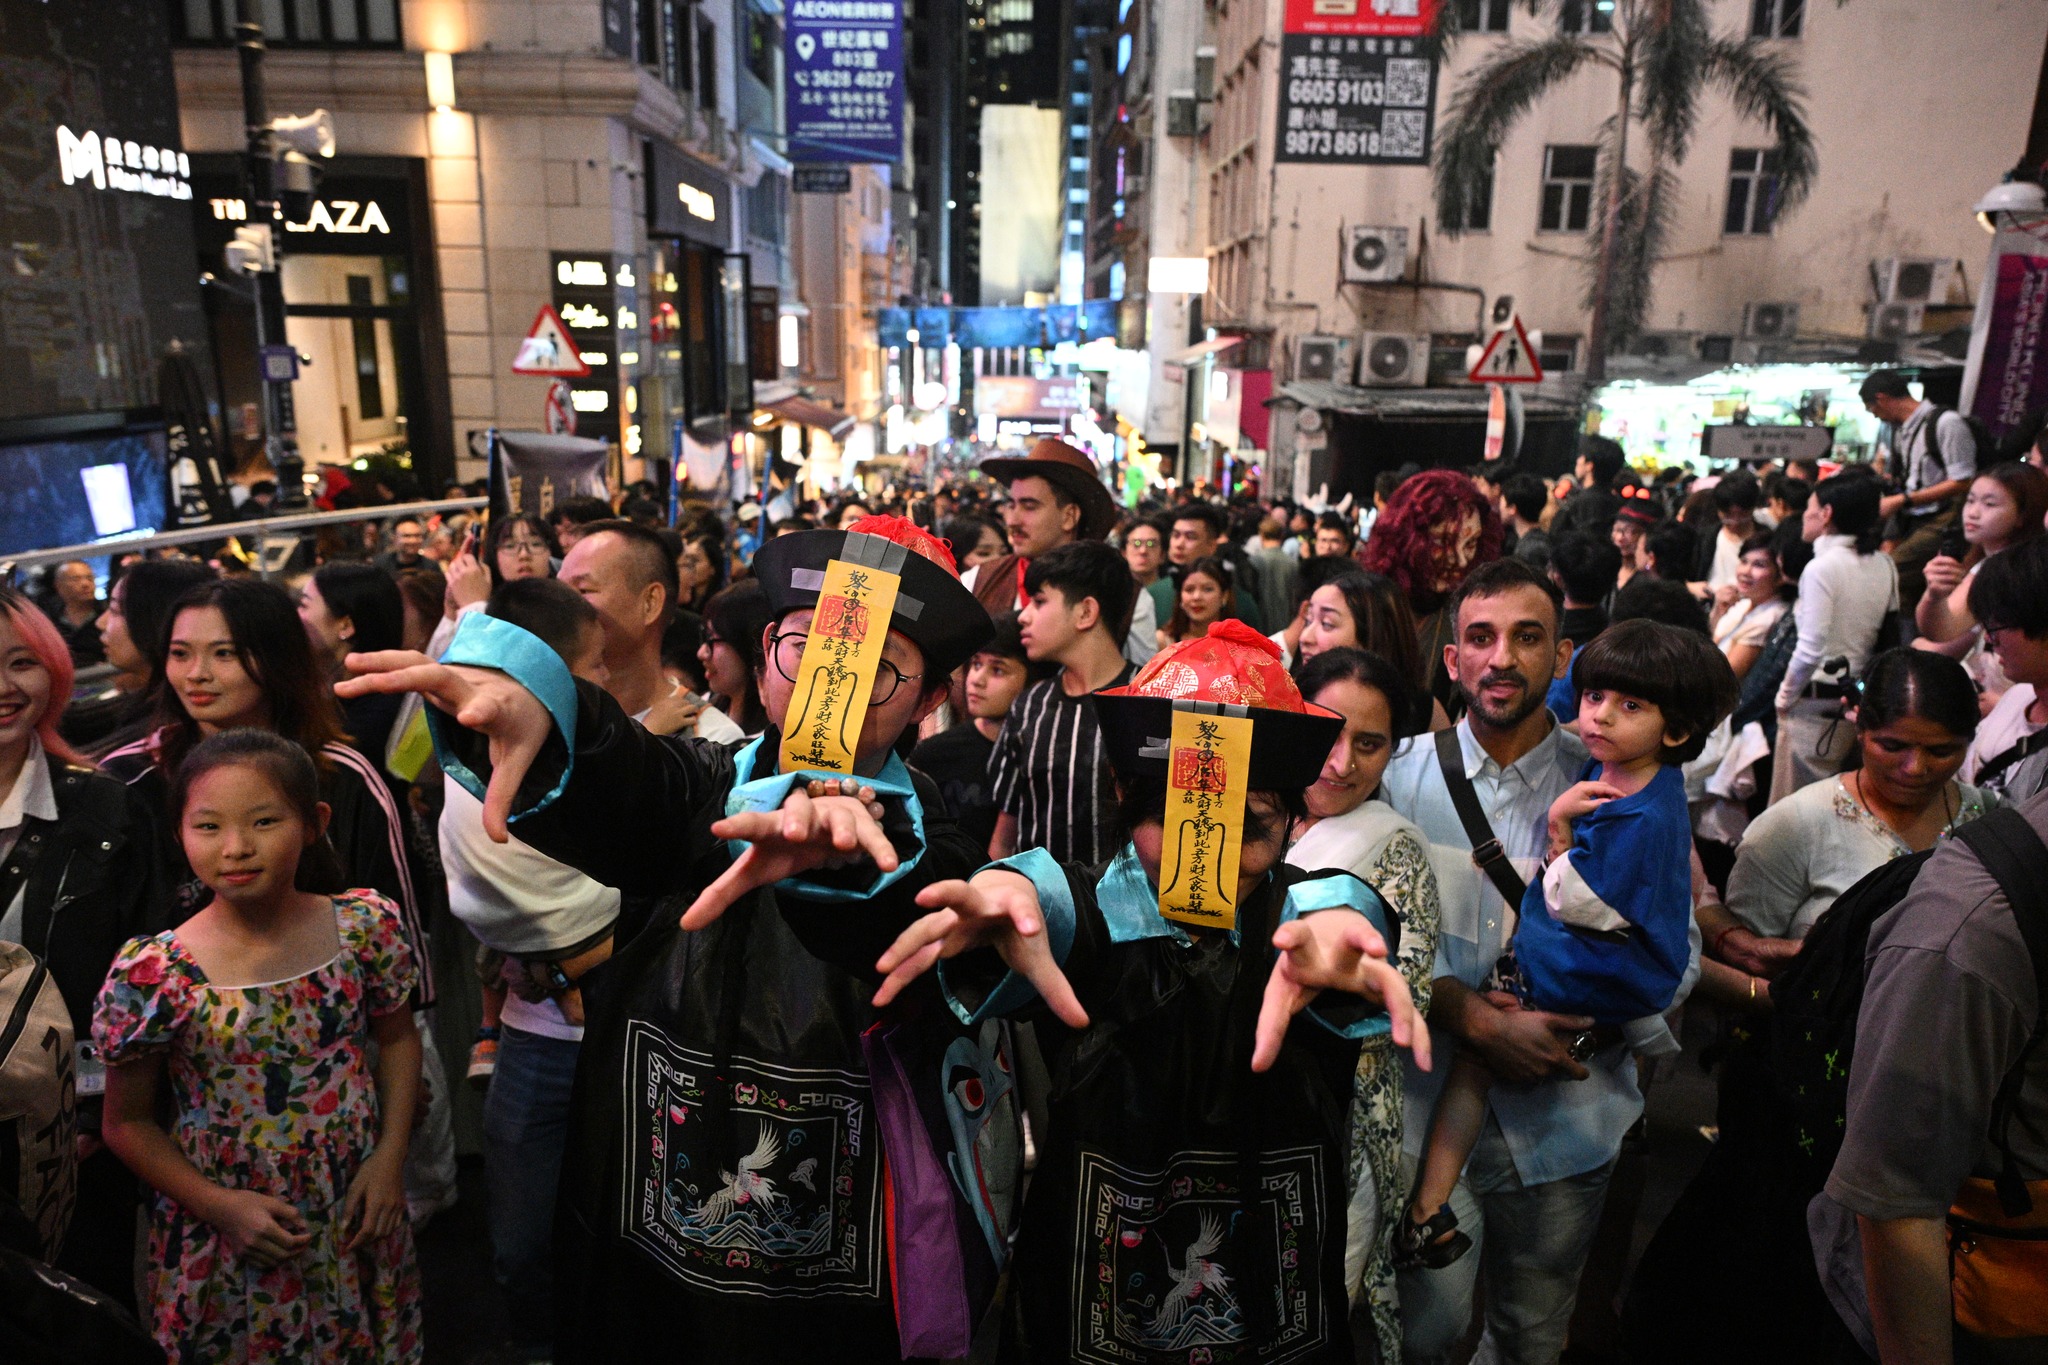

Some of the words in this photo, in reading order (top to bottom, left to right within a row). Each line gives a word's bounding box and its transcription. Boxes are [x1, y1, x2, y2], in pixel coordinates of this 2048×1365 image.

[811, 69, 852, 88] 3628
[854, 70, 895, 88] 4027
[1289, 78, 1337, 104] 6605
[1337, 80, 1385, 105] 9103
[1285, 130, 1333, 155] 9873
[1333, 130, 1381, 156] 8618
[209, 199, 247, 220] TH
